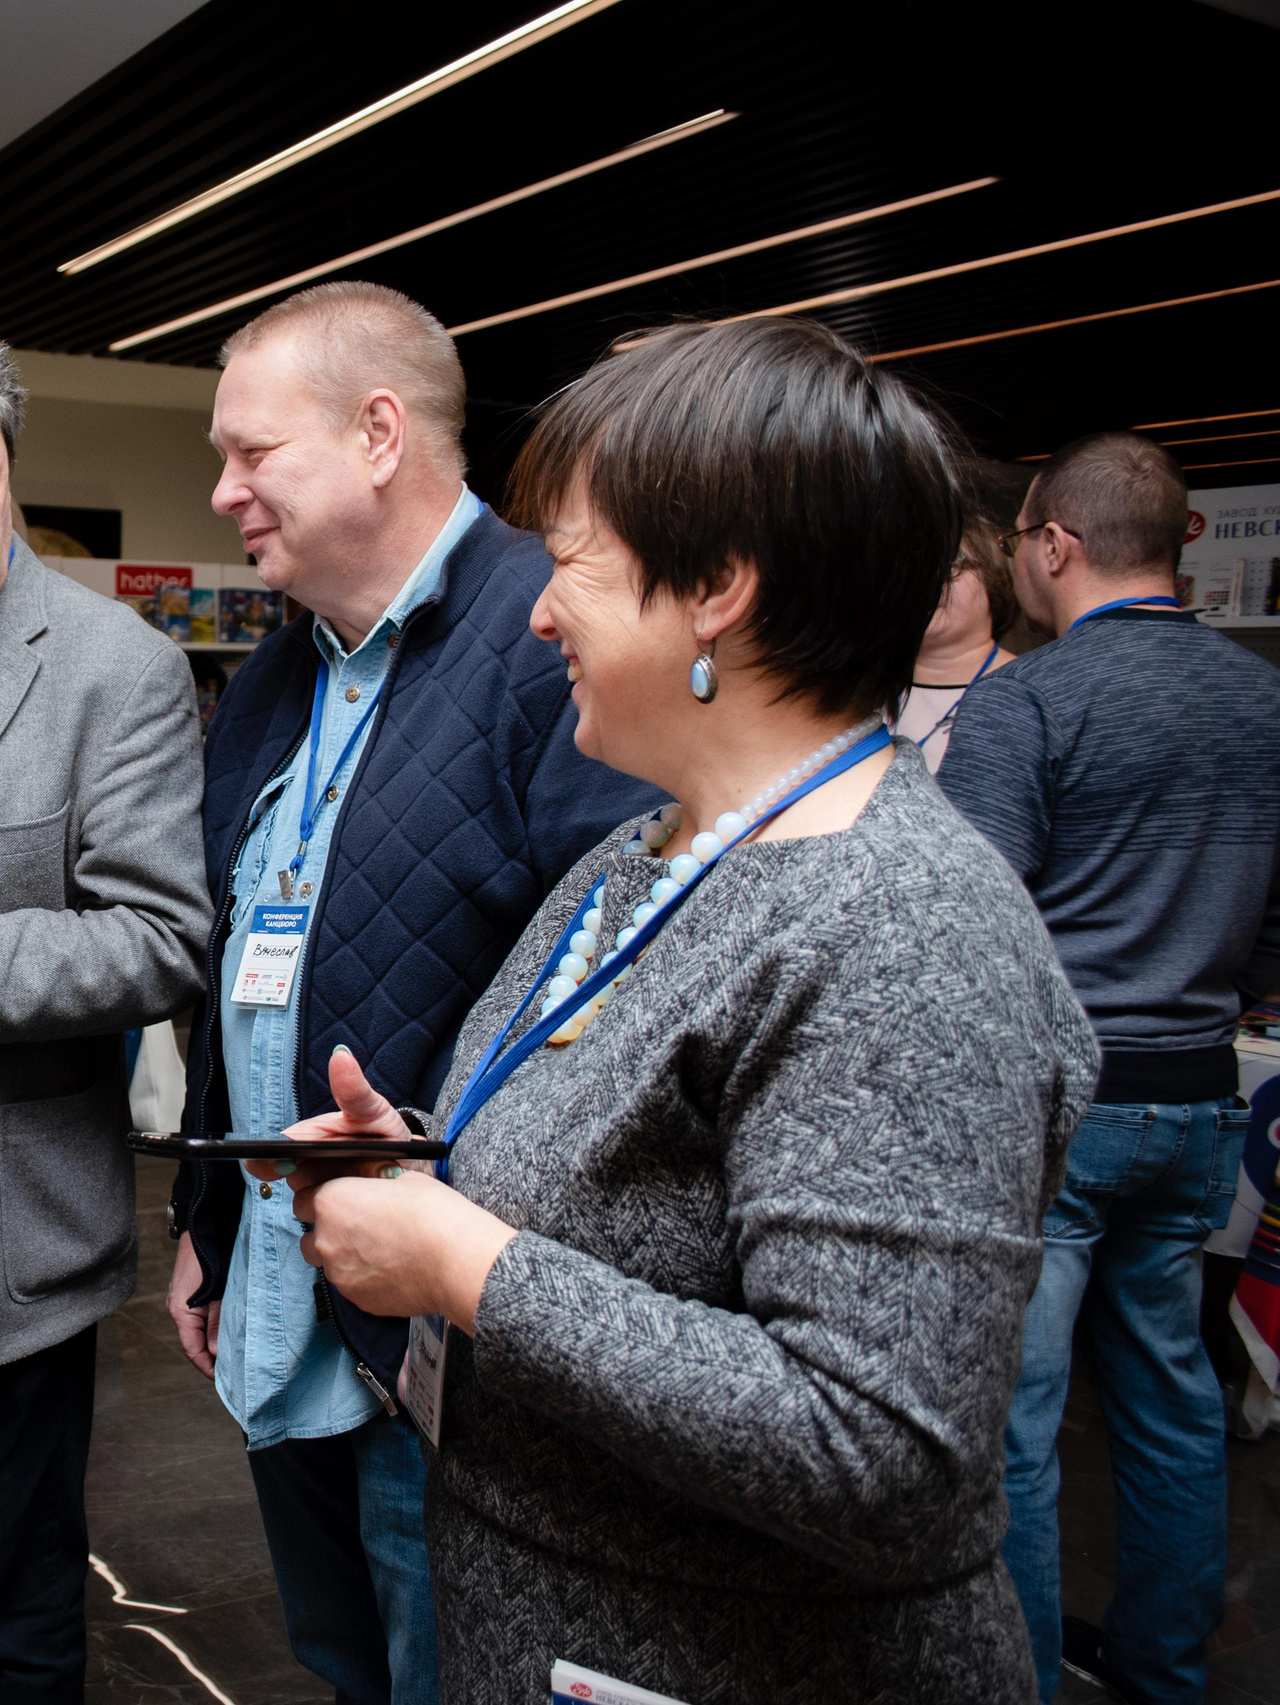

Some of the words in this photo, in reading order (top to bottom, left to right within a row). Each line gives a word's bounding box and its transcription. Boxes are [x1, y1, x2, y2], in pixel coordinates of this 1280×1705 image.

[1215, 507, 1257, 519] ЗАВОД
[262, 913, 303, 921] КОНФЕРЕНЦИЯ
[265, 920, 297, 929] КАНЦБЮРО
